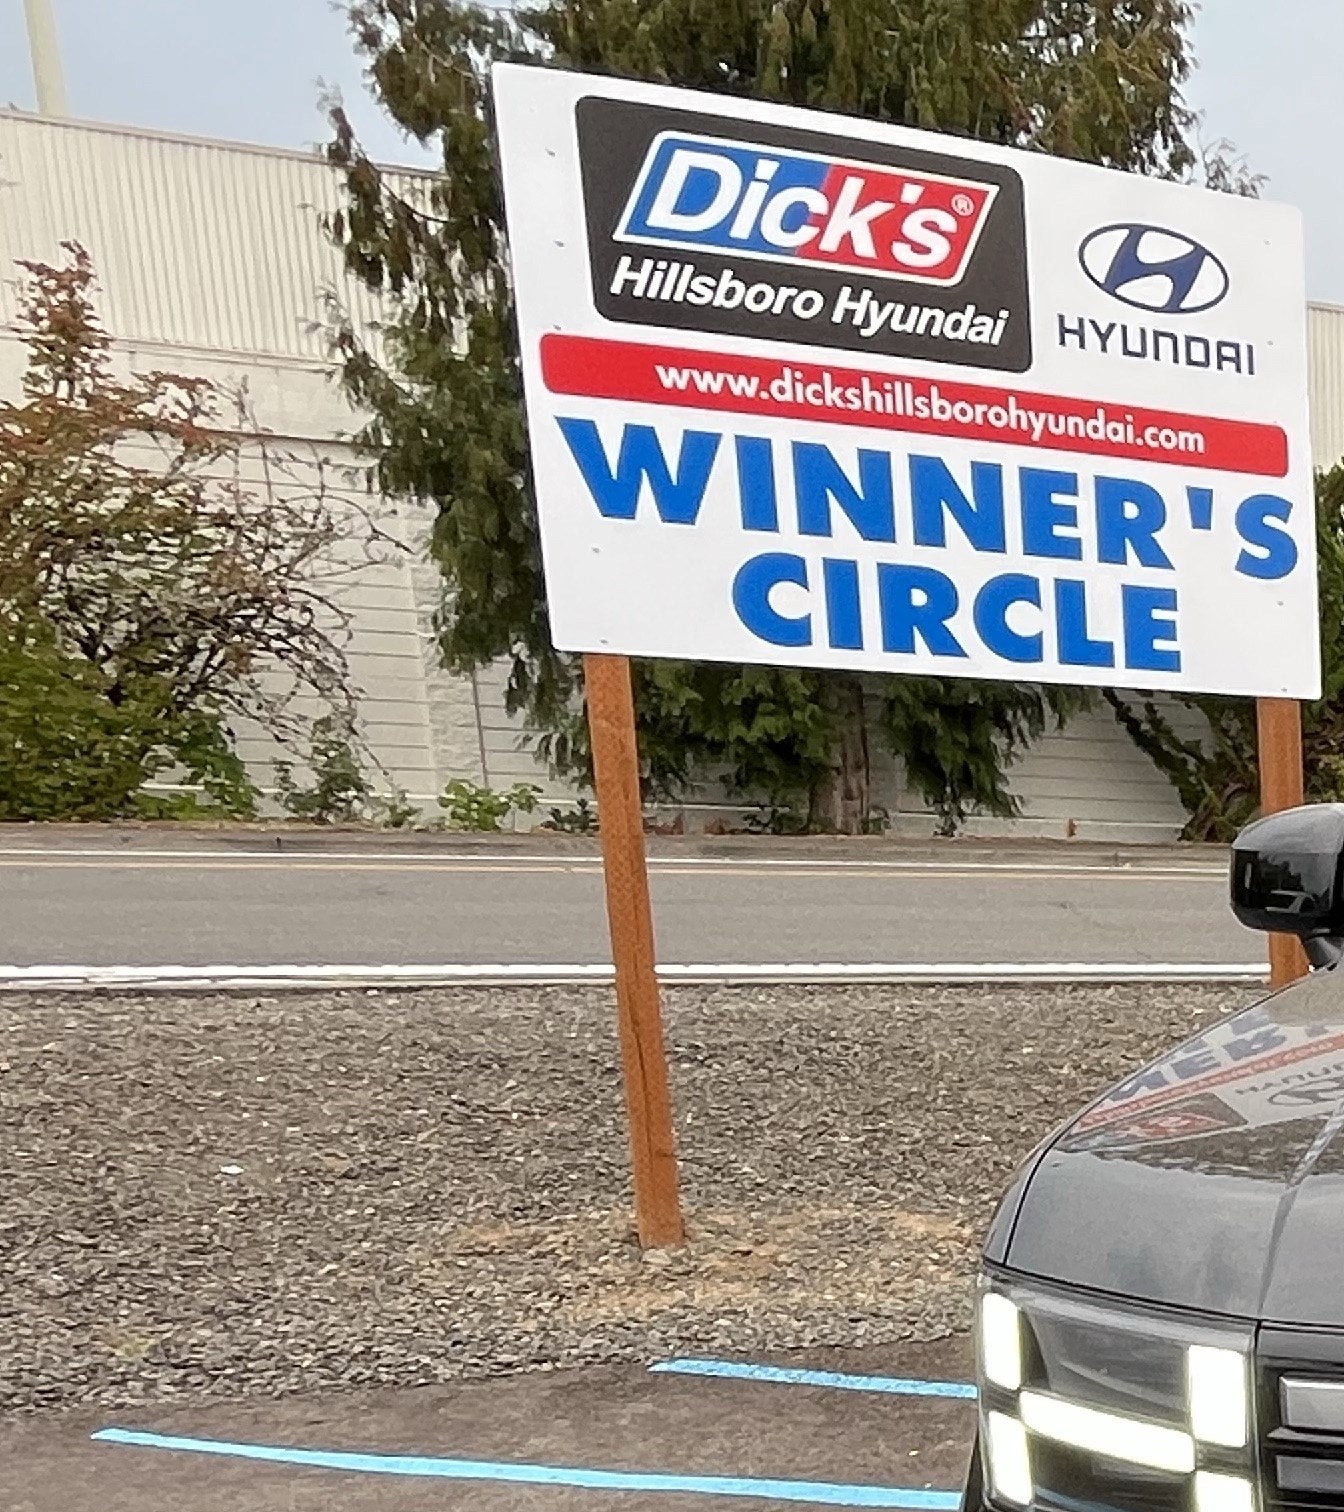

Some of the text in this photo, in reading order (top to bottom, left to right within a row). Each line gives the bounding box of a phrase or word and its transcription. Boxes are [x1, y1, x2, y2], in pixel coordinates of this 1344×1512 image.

[646, 148, 958, 268] Dick's
[609, 256, 1009, 346] Hillsboro Hyundai
[1057, 315, 1255, 376] HYUNDAI
[656, 360, 1205, 454] www.dickshillsborohyundai.com
[553, 415, 1298, 580] WINNER'S
[732, 552, 1182, 673] CIRCLE
